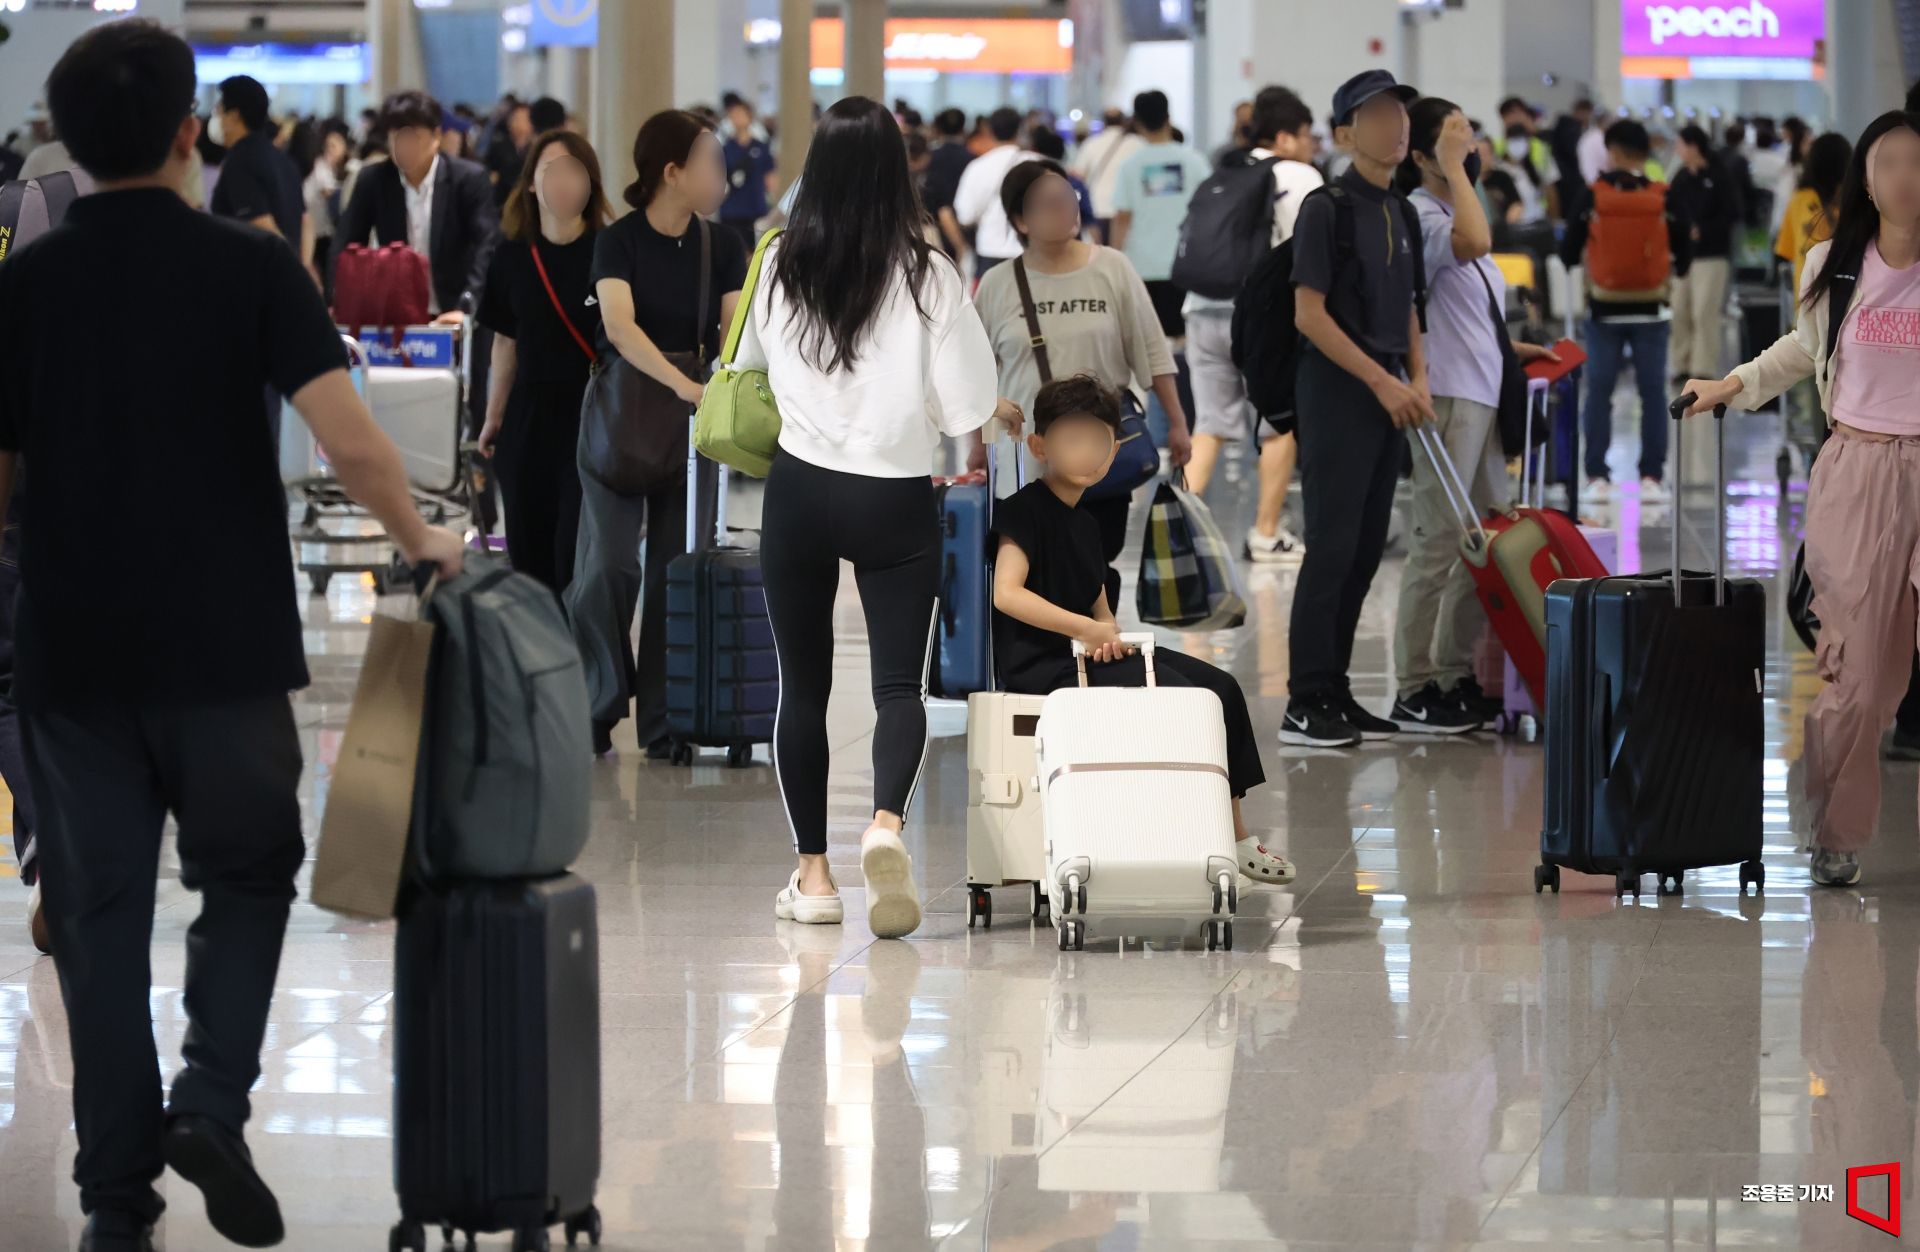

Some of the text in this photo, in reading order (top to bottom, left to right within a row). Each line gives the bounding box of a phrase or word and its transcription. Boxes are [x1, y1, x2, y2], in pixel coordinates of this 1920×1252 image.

[1645, 0, 1779, 45] peach
[1060, 299, 1107, 314] AFTER
[1858, 309, 1920, 323] MARITH
